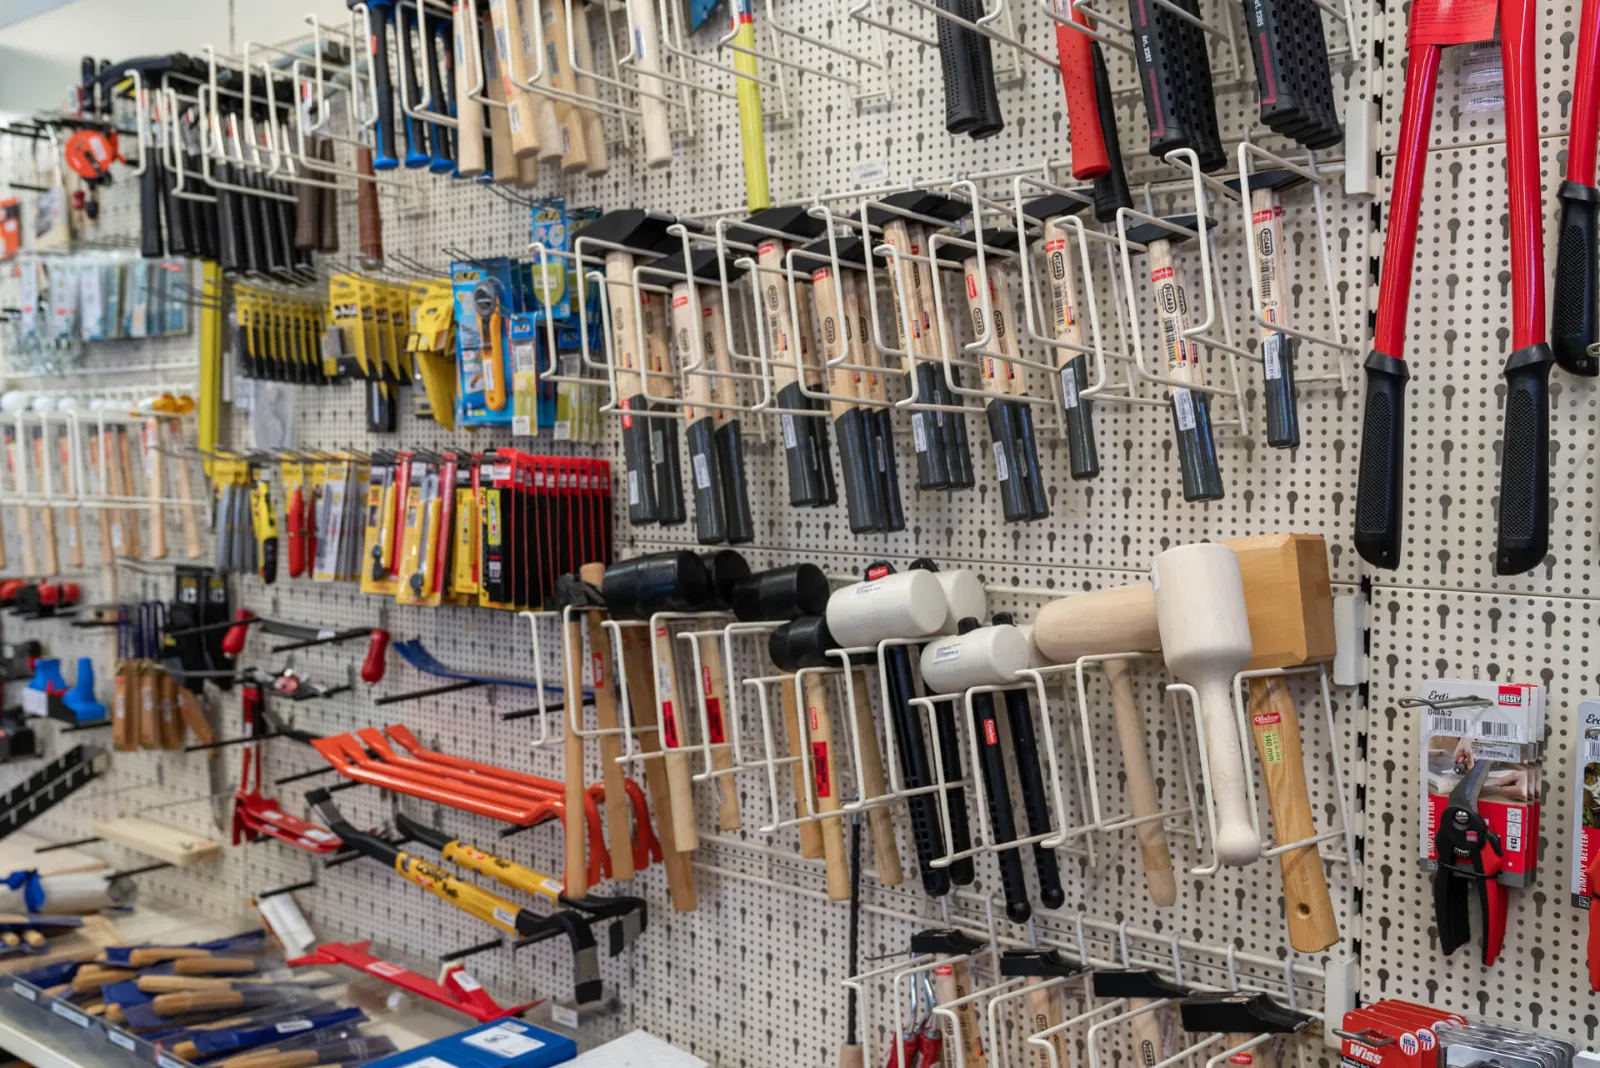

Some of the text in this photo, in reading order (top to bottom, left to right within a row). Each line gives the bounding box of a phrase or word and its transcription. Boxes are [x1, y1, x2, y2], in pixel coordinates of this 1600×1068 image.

[1164, 285, 1174, 311] PICARD
[1428, 690, 1449, 700] Erdi
[1267, 747, 1273, 761] mm
[1403, 1037, 1416, 1047] USA
[1418, 1033, 1432, 1043] USA
